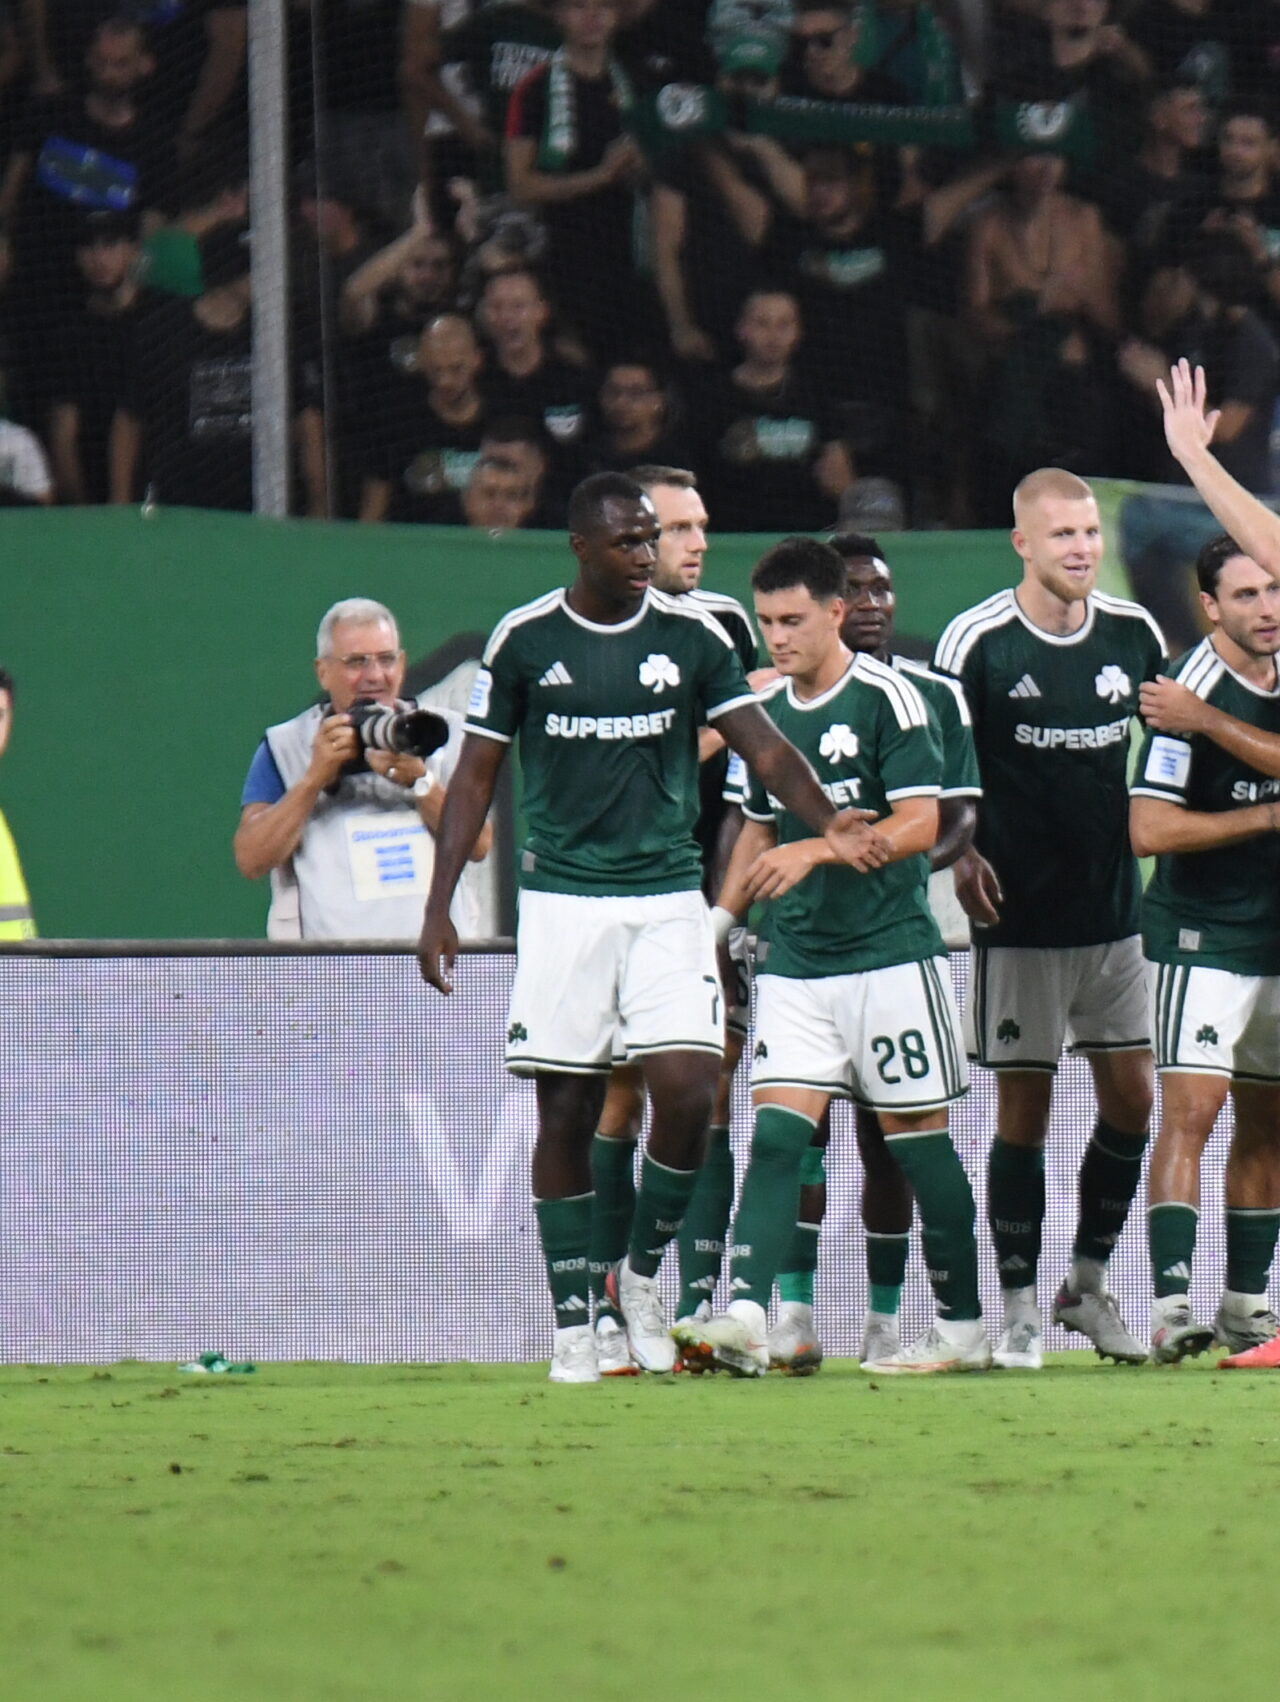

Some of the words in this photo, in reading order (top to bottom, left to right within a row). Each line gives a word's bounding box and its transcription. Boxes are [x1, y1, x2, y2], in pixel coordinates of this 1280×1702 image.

[544, 707, 677, 740] SUPERBET
[1014, 715, 1131, 750] SUPERBET
[871, 1028, 930, 1085] 28
[552, 1257, 587, 1273] 1908
